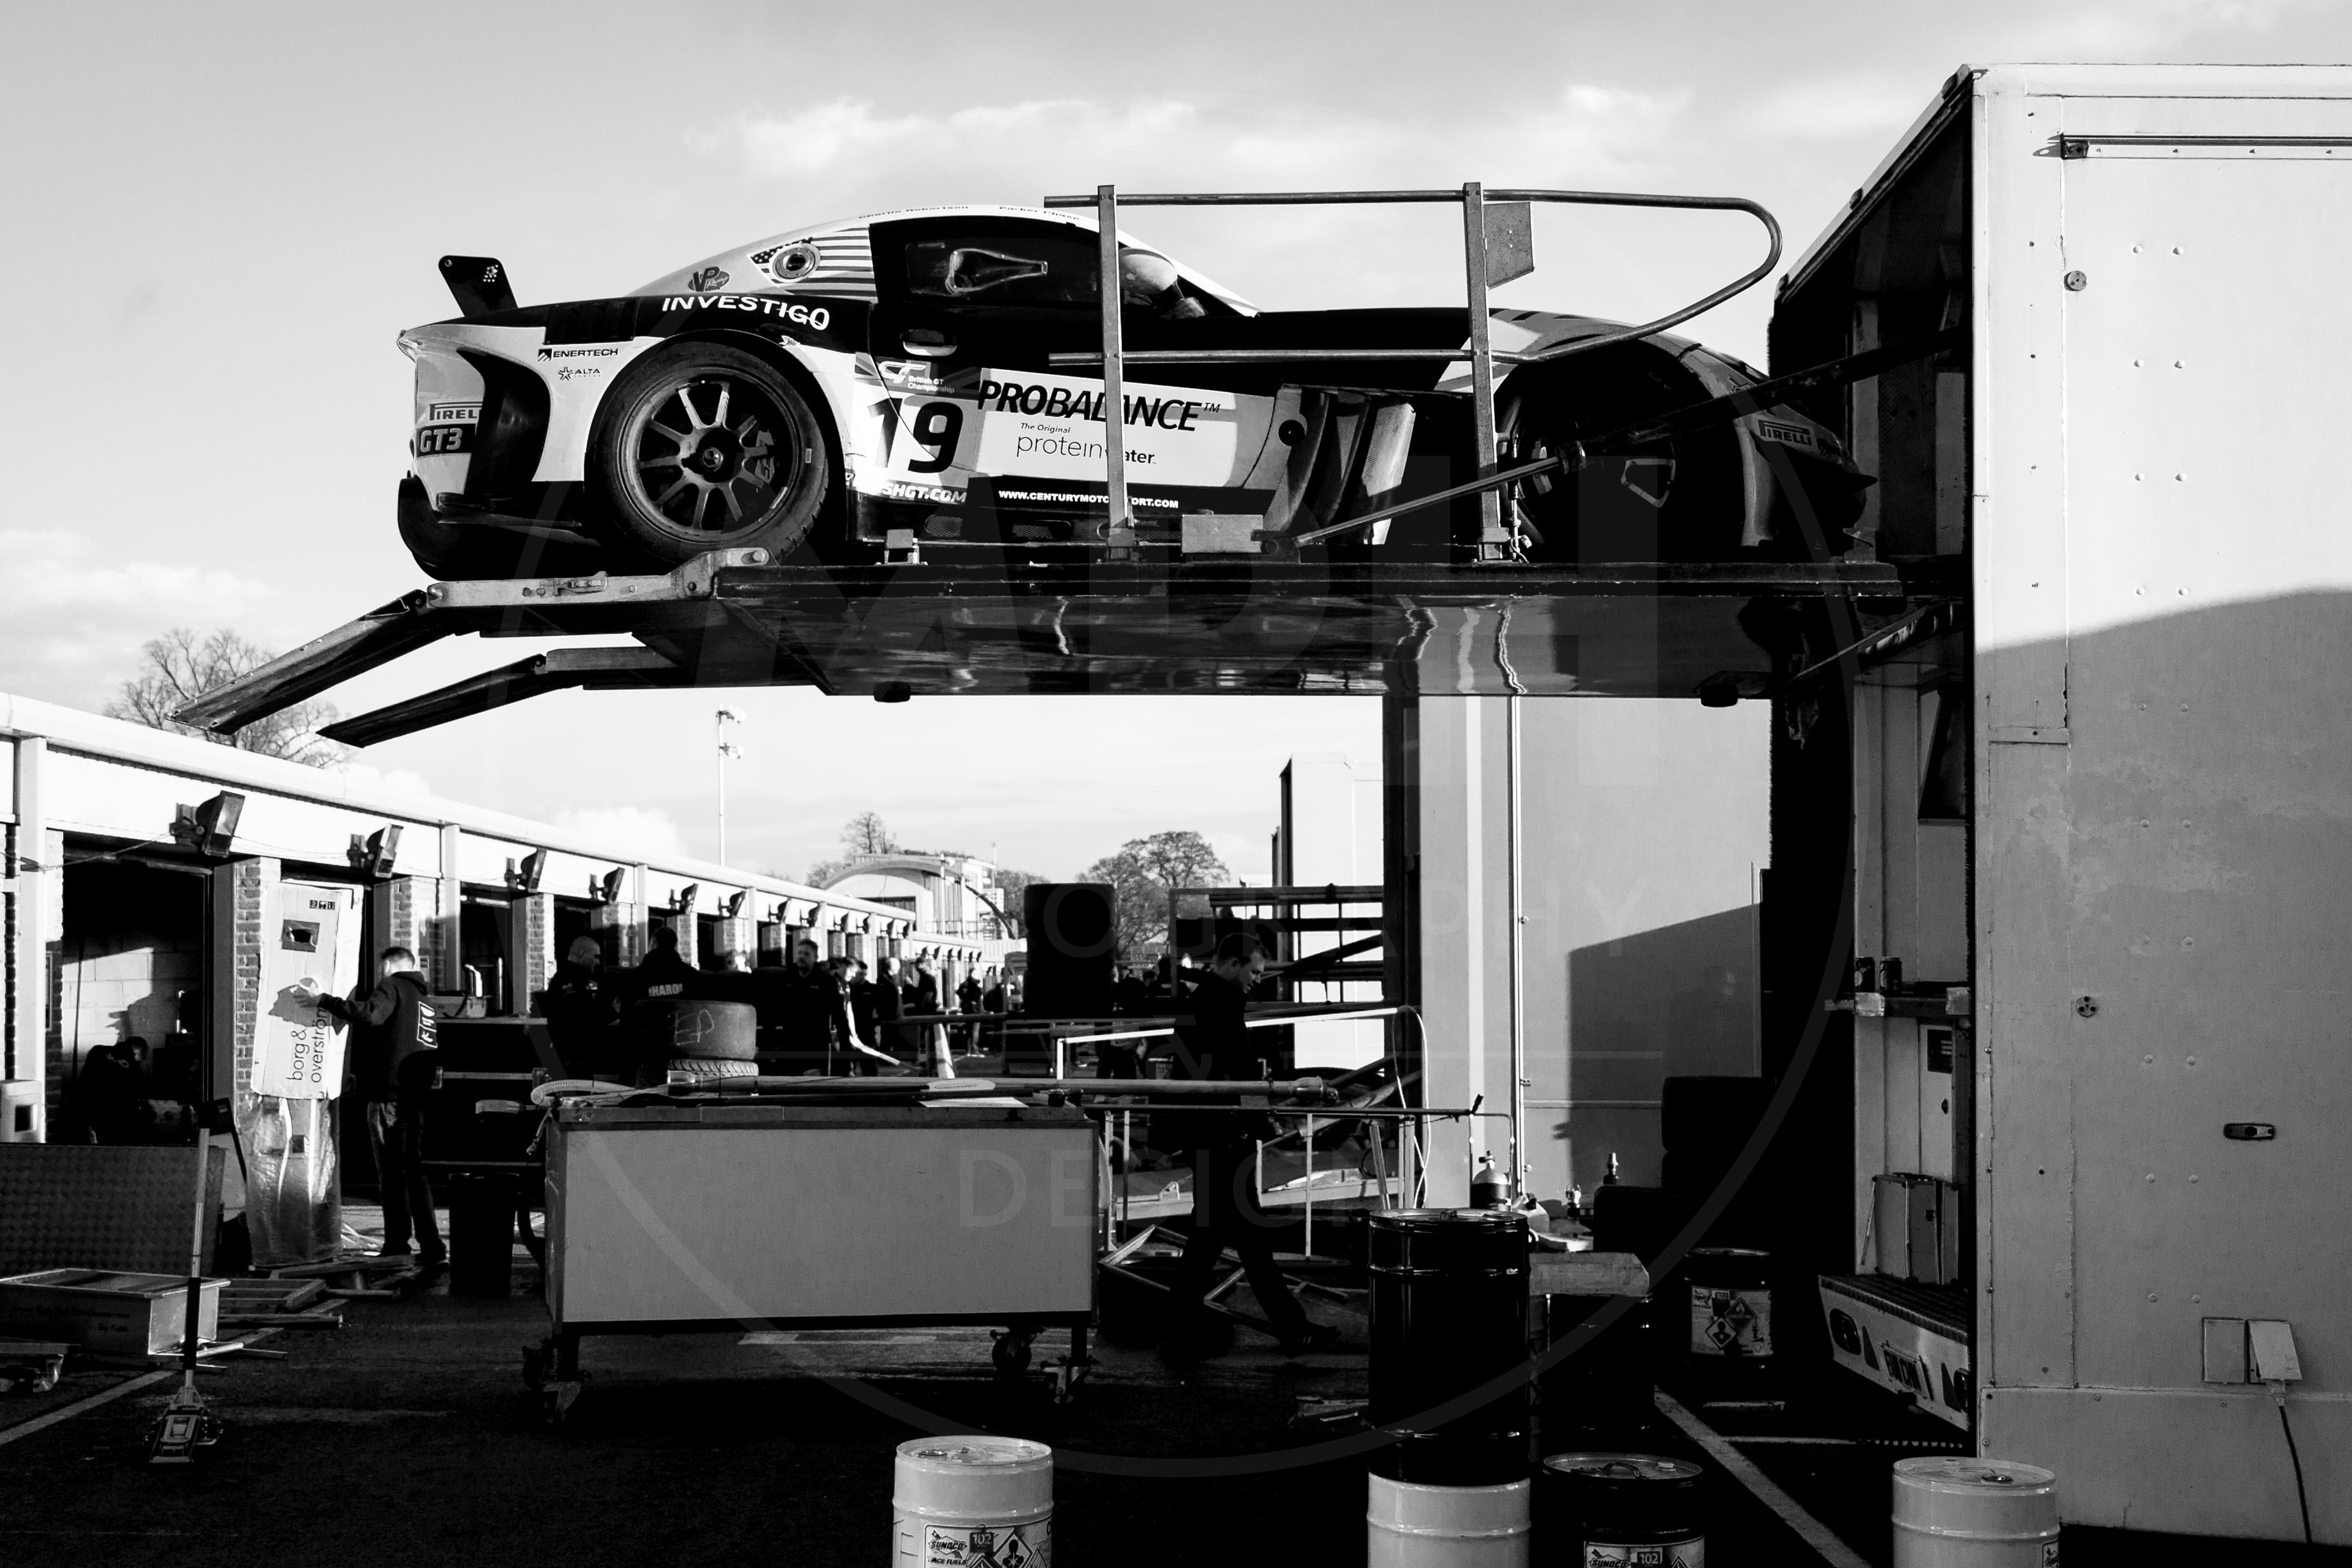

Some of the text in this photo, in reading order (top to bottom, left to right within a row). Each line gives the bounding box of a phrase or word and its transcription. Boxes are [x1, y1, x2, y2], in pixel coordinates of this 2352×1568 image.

[693, 266, 720, 292] VP
[662, 296, 830, 331] INVESTIGO
[553, 349, 618, 358] ENERTECH
[908, 375, 932, 384] British
[908, 382, 955, 394] Championship
[430, 402, 483, 421] PIREL
[867, 398, 964, 473] 19
[1037, 424, 1071, 434] Original
[1757, 419, 1812, 446] PIRELLI
[420, 428, 464, 453] GT3
[998, 491, 1179, 509] WWW.CENTURYMOTOORT.COM
[286, 1028, 310, 1081] borg &
[930, 1540, 964, 1551] SUNOCO
[973, 1533, 991, 1545] 102
[1593, 1559, 1628, 1568] SUNOCO
[1638, 1553, 1659, 1565] 102
